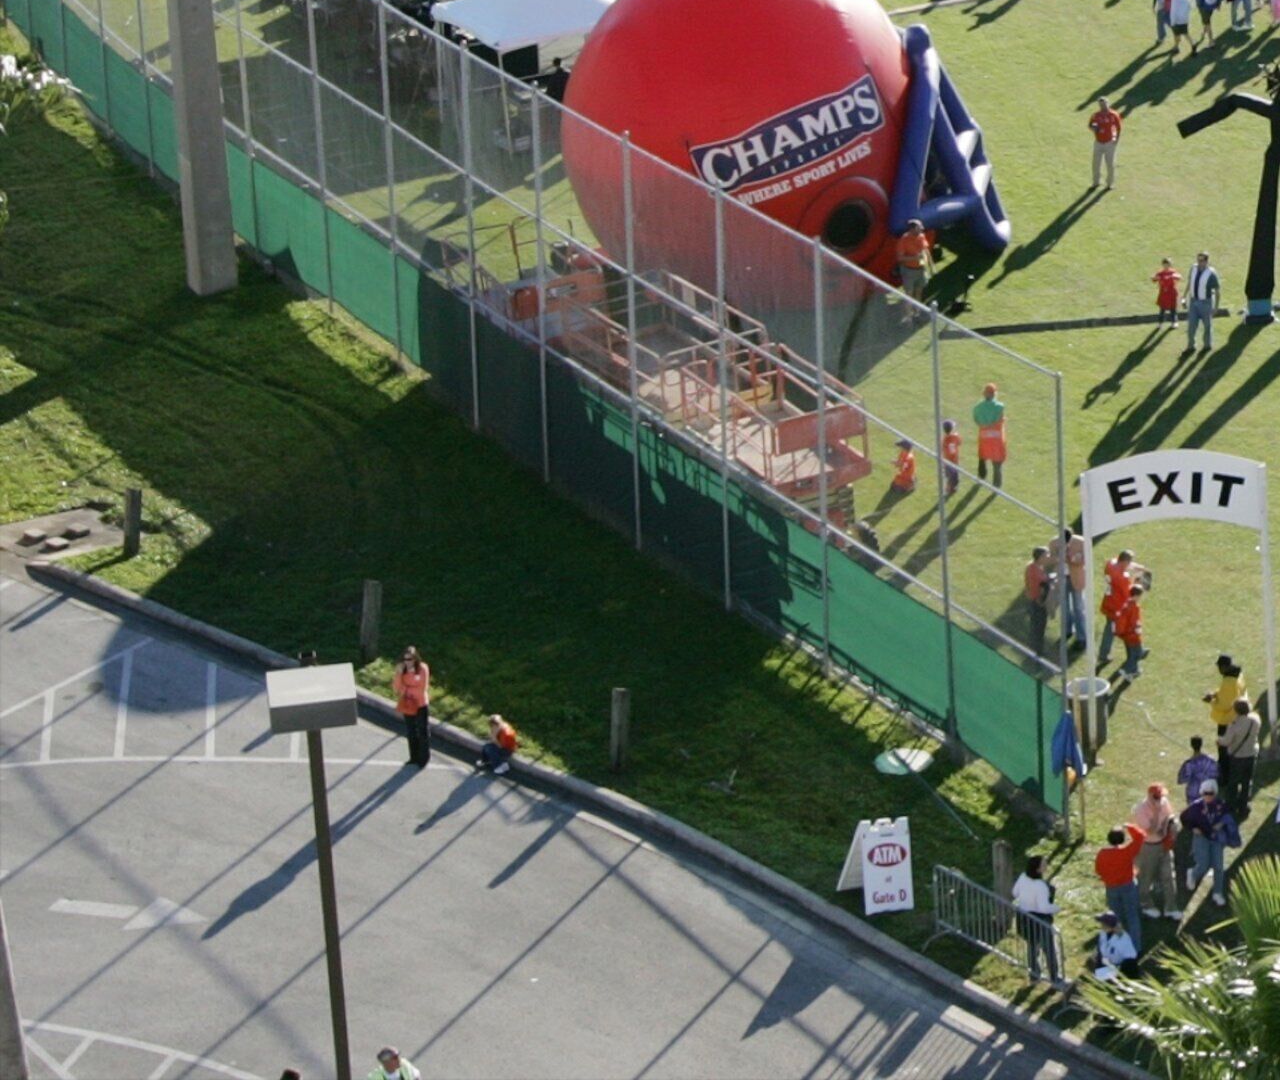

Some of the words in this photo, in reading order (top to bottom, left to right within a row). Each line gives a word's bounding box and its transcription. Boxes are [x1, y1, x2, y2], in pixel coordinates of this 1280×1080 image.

[702, 83, 880, 189] CHAMPS
[738, 179, 792, 206] WHERE
[793, 157, 837, 189] SPORT
[838, 140, 873, 170] LIVES
[1107, 471, 1246, 514] EXIT
[872, 845, 902, 865] ATM
[872, 890, 896, 905] Gate
[899, 888, 907, 902] D
